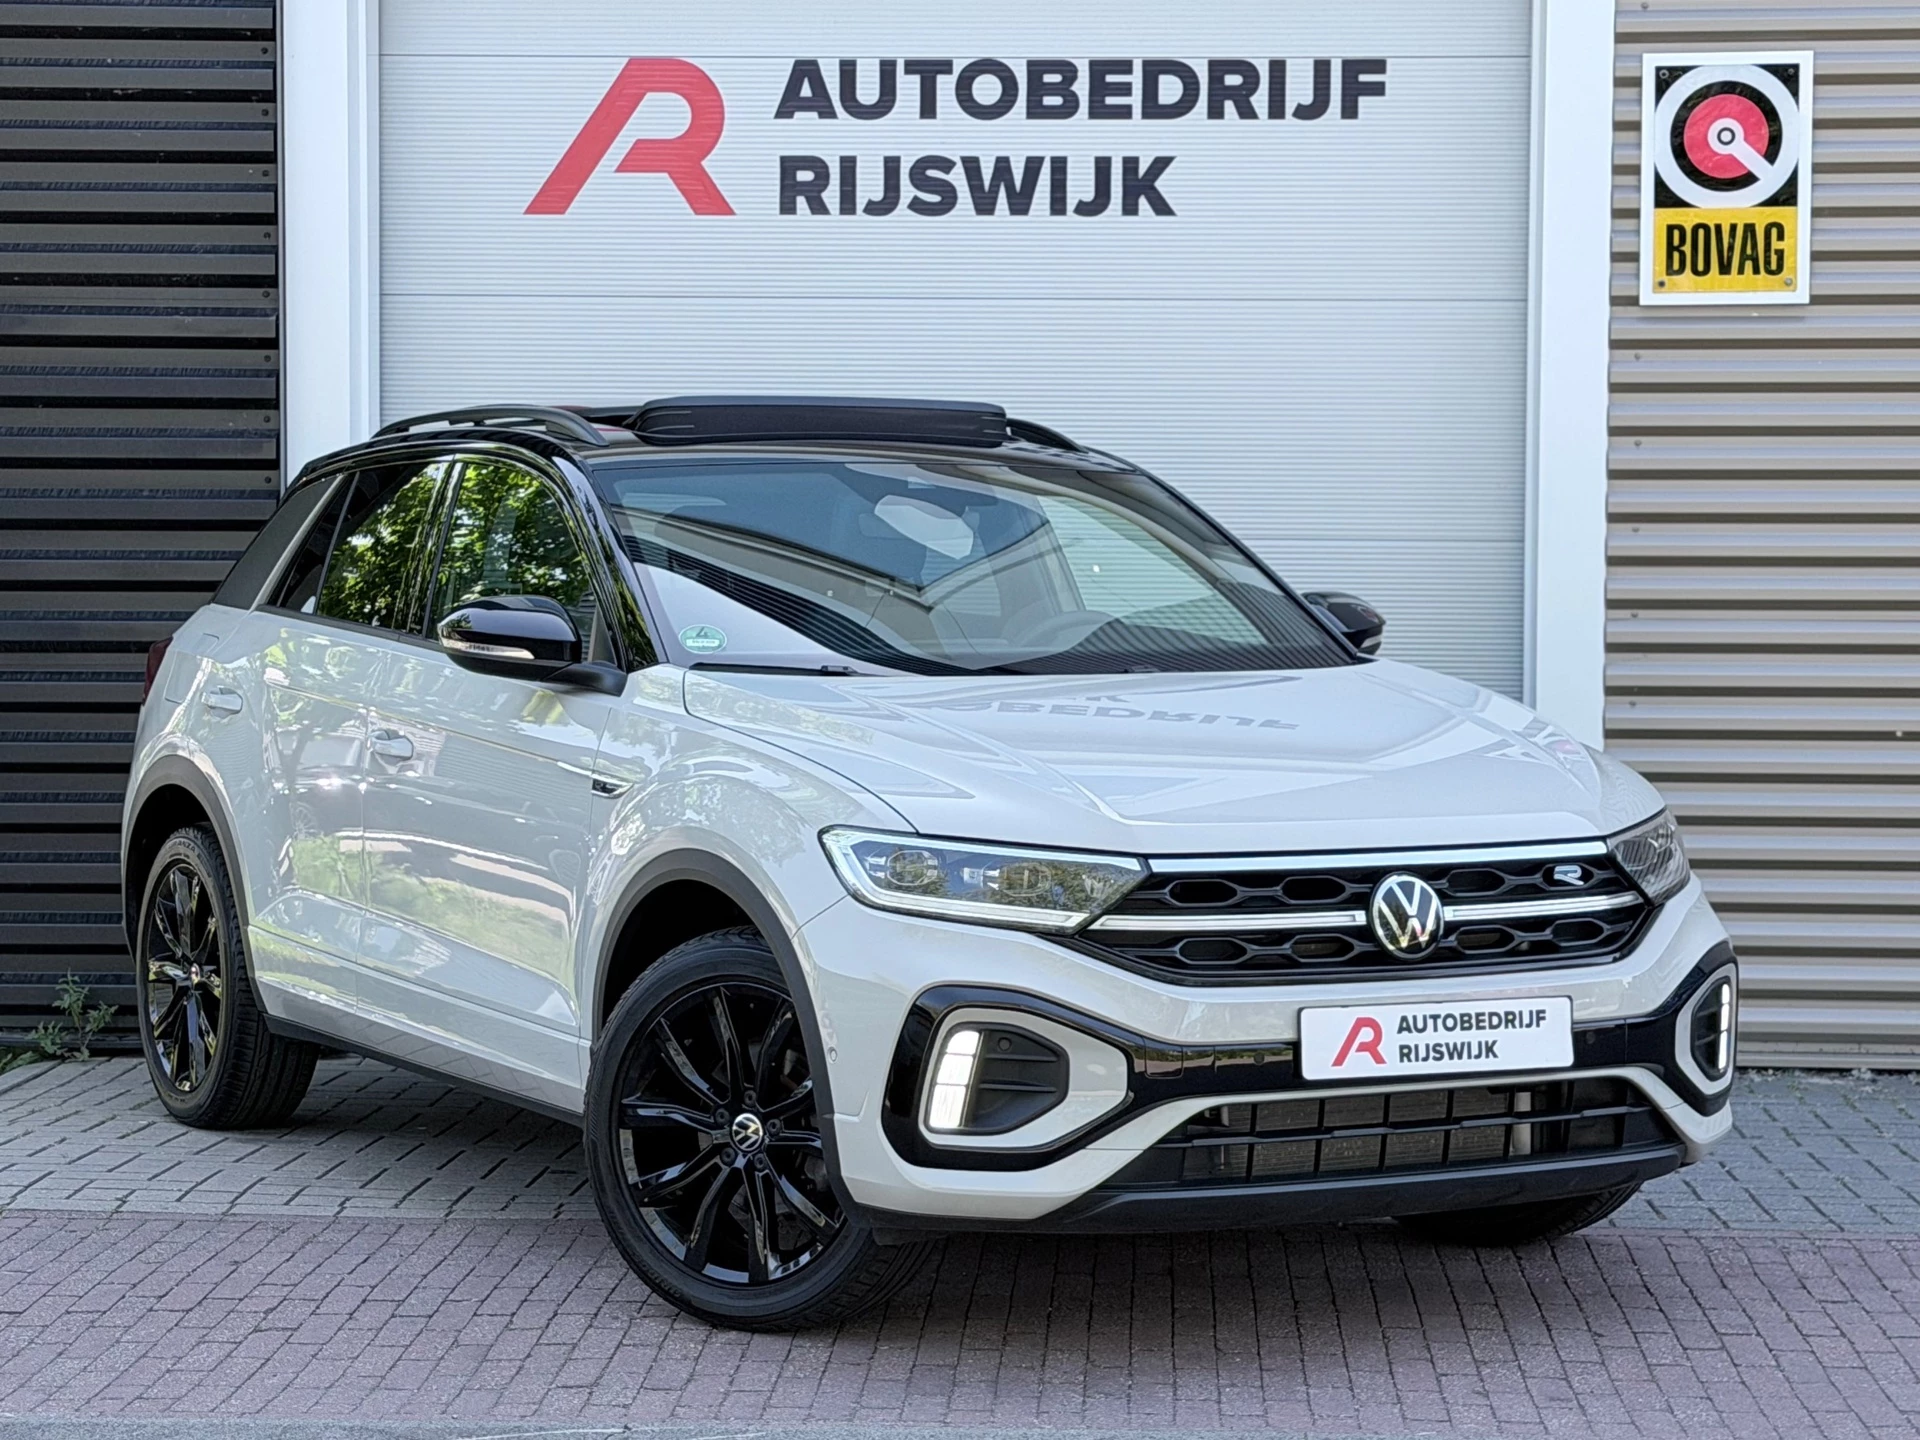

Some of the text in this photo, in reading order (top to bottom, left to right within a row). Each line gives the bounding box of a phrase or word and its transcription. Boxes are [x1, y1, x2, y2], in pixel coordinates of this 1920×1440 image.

[773, 58, 1388, 120] AUTOBEDRIJF
[778, 155, 1177, 217] RIJSWIJK
[1665, 221, 1786, 277] BOVAG
[1396, 1009, 1547, 1035] AUTOBEDRIJF
[1398, 1040, 1499, 1064] RIJSWIJK
